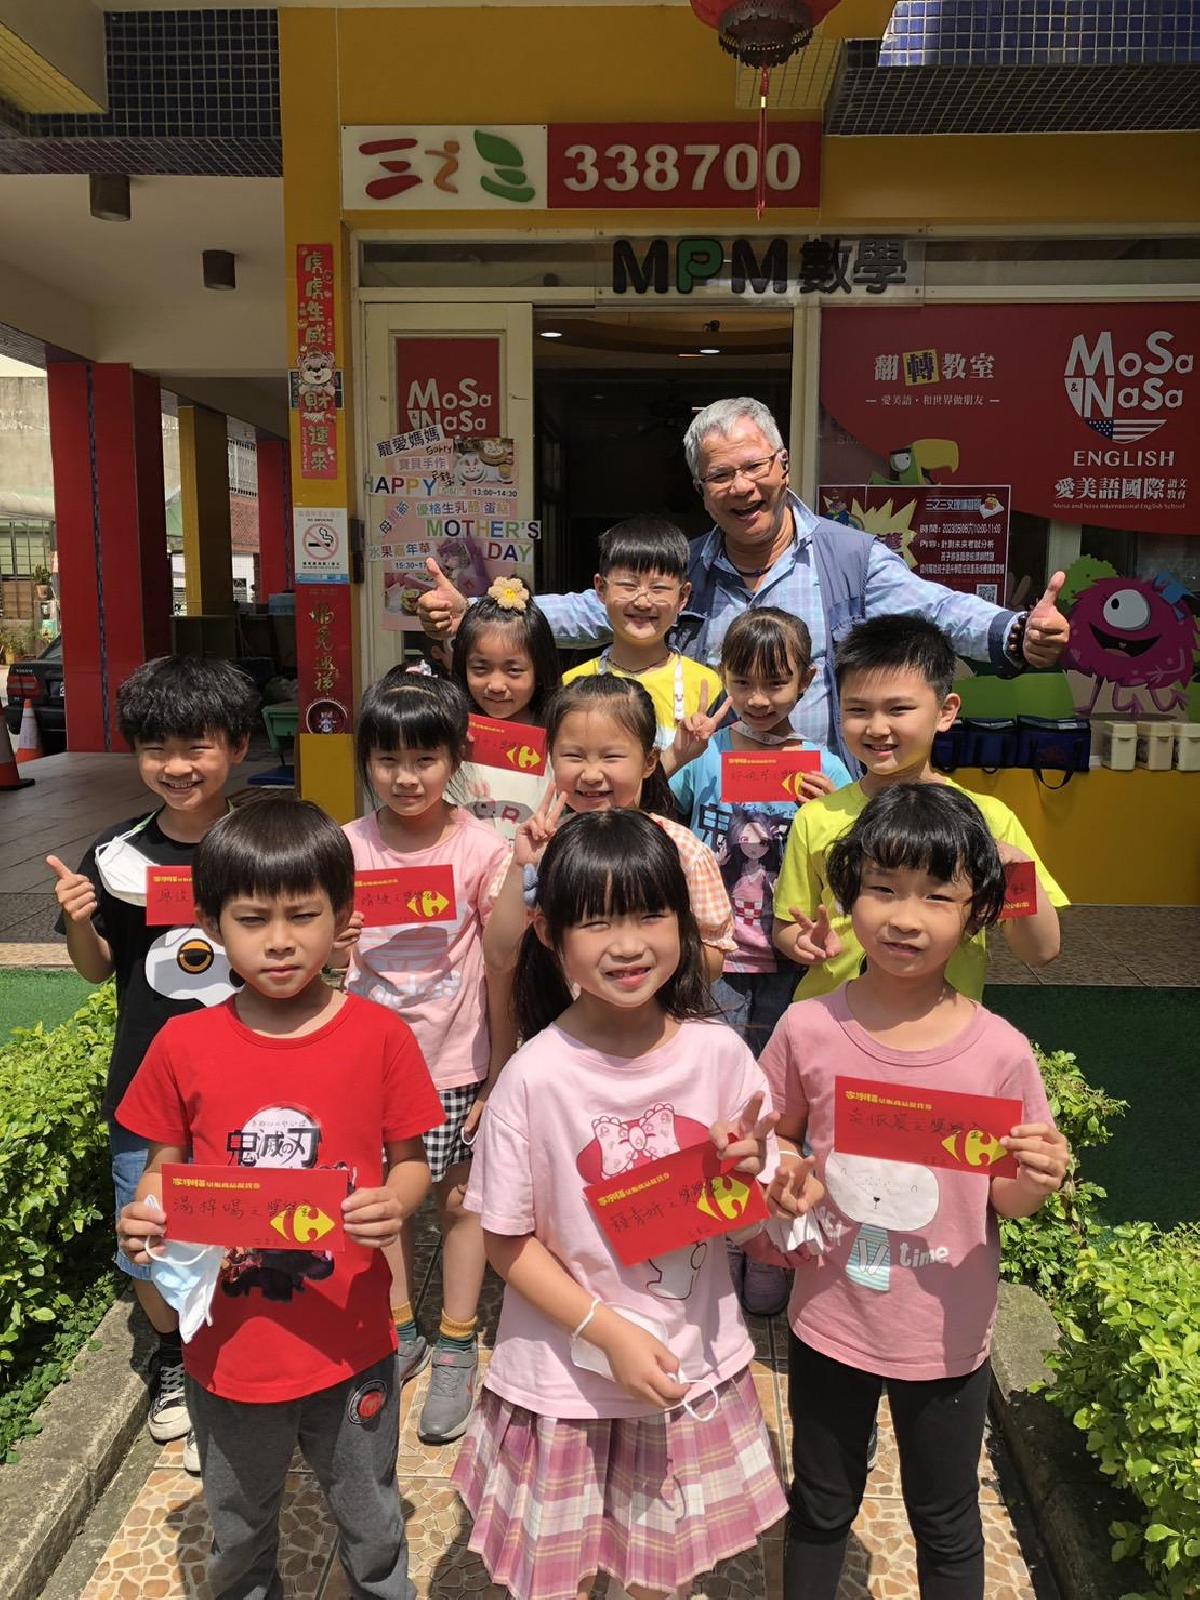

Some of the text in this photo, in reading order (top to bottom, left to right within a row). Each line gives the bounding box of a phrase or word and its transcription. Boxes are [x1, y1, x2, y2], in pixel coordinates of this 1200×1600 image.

[563, 143, 801, 192] 338700
[874, 352, 995, 384] 翻轉教室
[1064, 331, 1194, 376] MoSa
[406, 378, 492, 409] MoSa
[376, 426, 441, 458] 寵愛媽媽
[1073, 451, 1175, 467] ENGLISH
[364, 475, 437, 497] HAPPY
[1055, 477, 1165, 500] 愛美語國際
[427, 519, 539, 539] MOTHER'S
[488, 542, 532, 562] DAY
[226, 1127, 321, 1168] 鬼滅の刃
[899, 1241, 949, 1268] time
